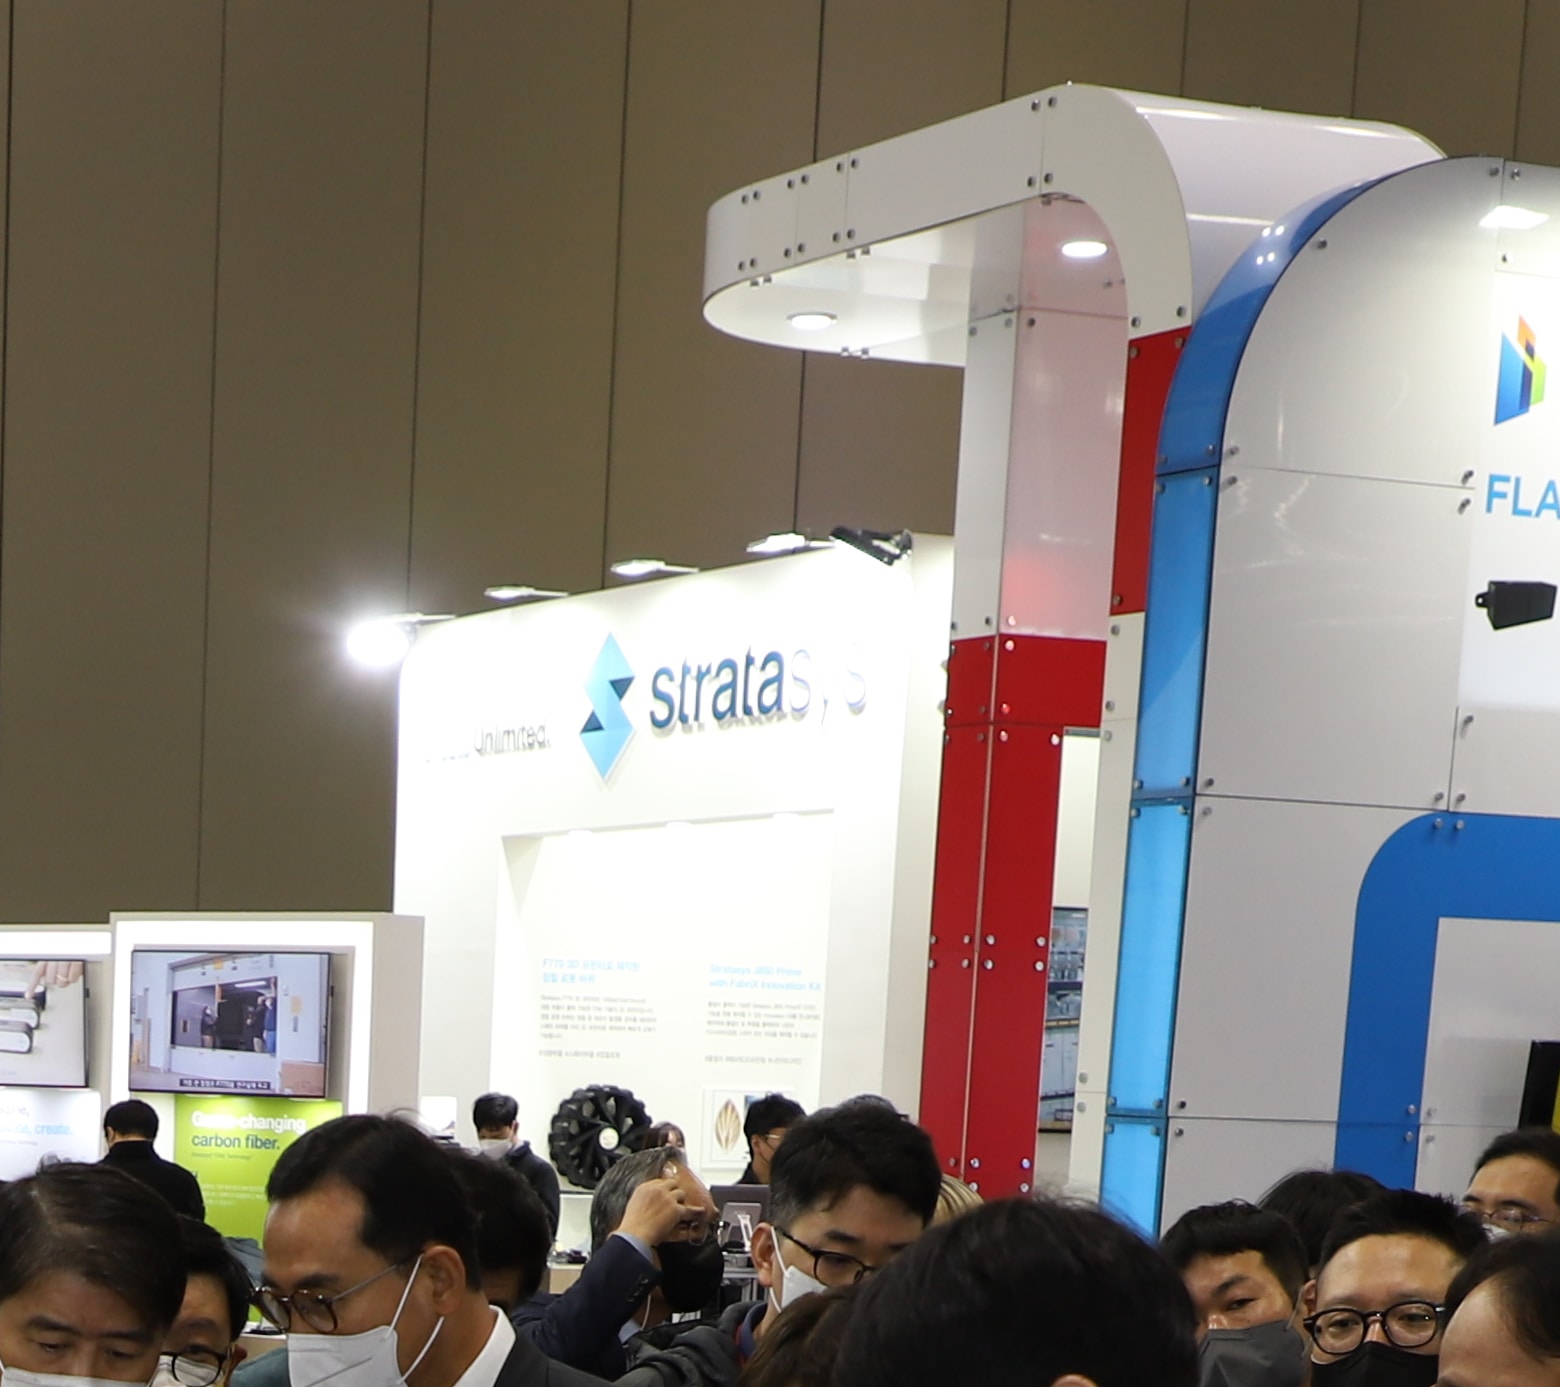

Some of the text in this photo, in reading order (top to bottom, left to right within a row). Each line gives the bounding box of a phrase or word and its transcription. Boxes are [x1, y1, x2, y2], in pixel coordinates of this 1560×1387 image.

[34, 1121, 73, 1136] create.
[191, 1133, 281, 1150] carbon fiber.
